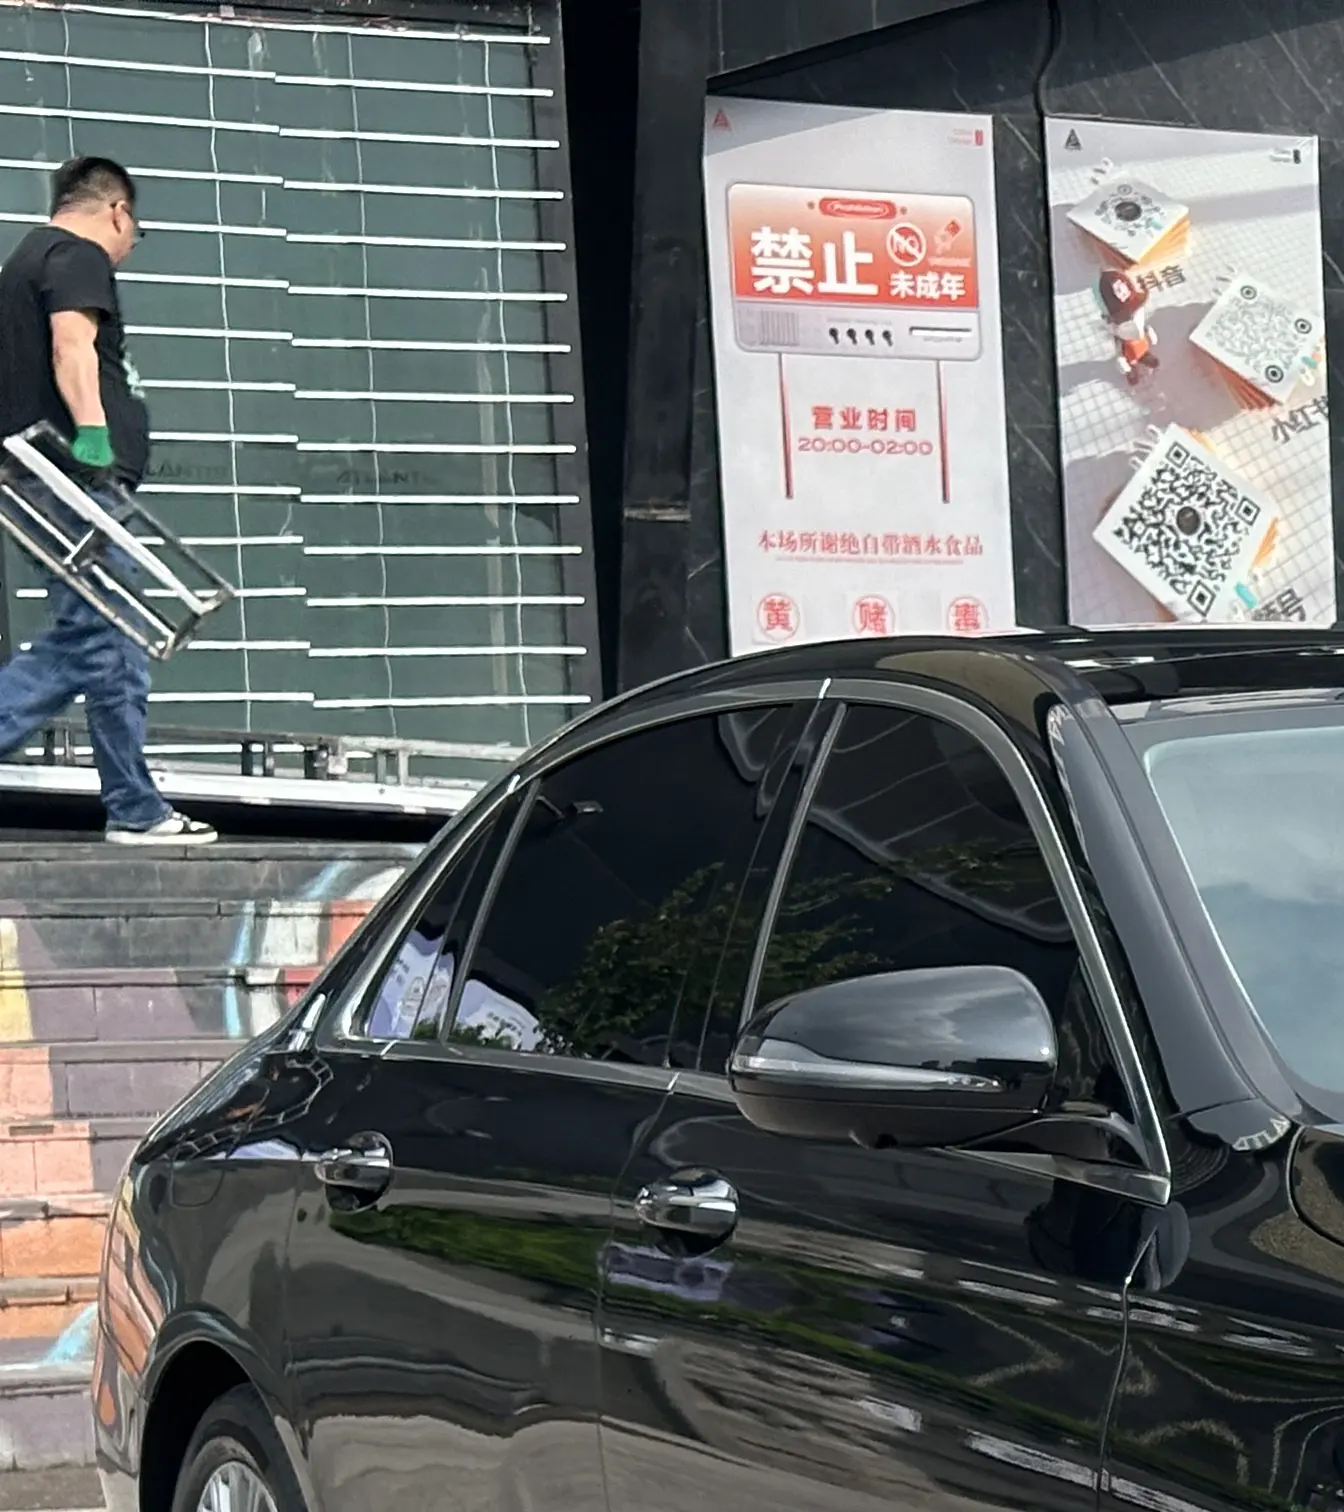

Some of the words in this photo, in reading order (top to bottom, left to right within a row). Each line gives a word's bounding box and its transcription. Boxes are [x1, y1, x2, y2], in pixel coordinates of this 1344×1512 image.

[751, 226, 879, 296] 禁止
[889, 270, 966, 301] 未成年
[1136, 264, 1188, 294] 抖音
[812, 405, 917, 432] 营业时间
[798, 437, 934, 456] 20:00-02:00
[764, 598, 793, 632] 黄
